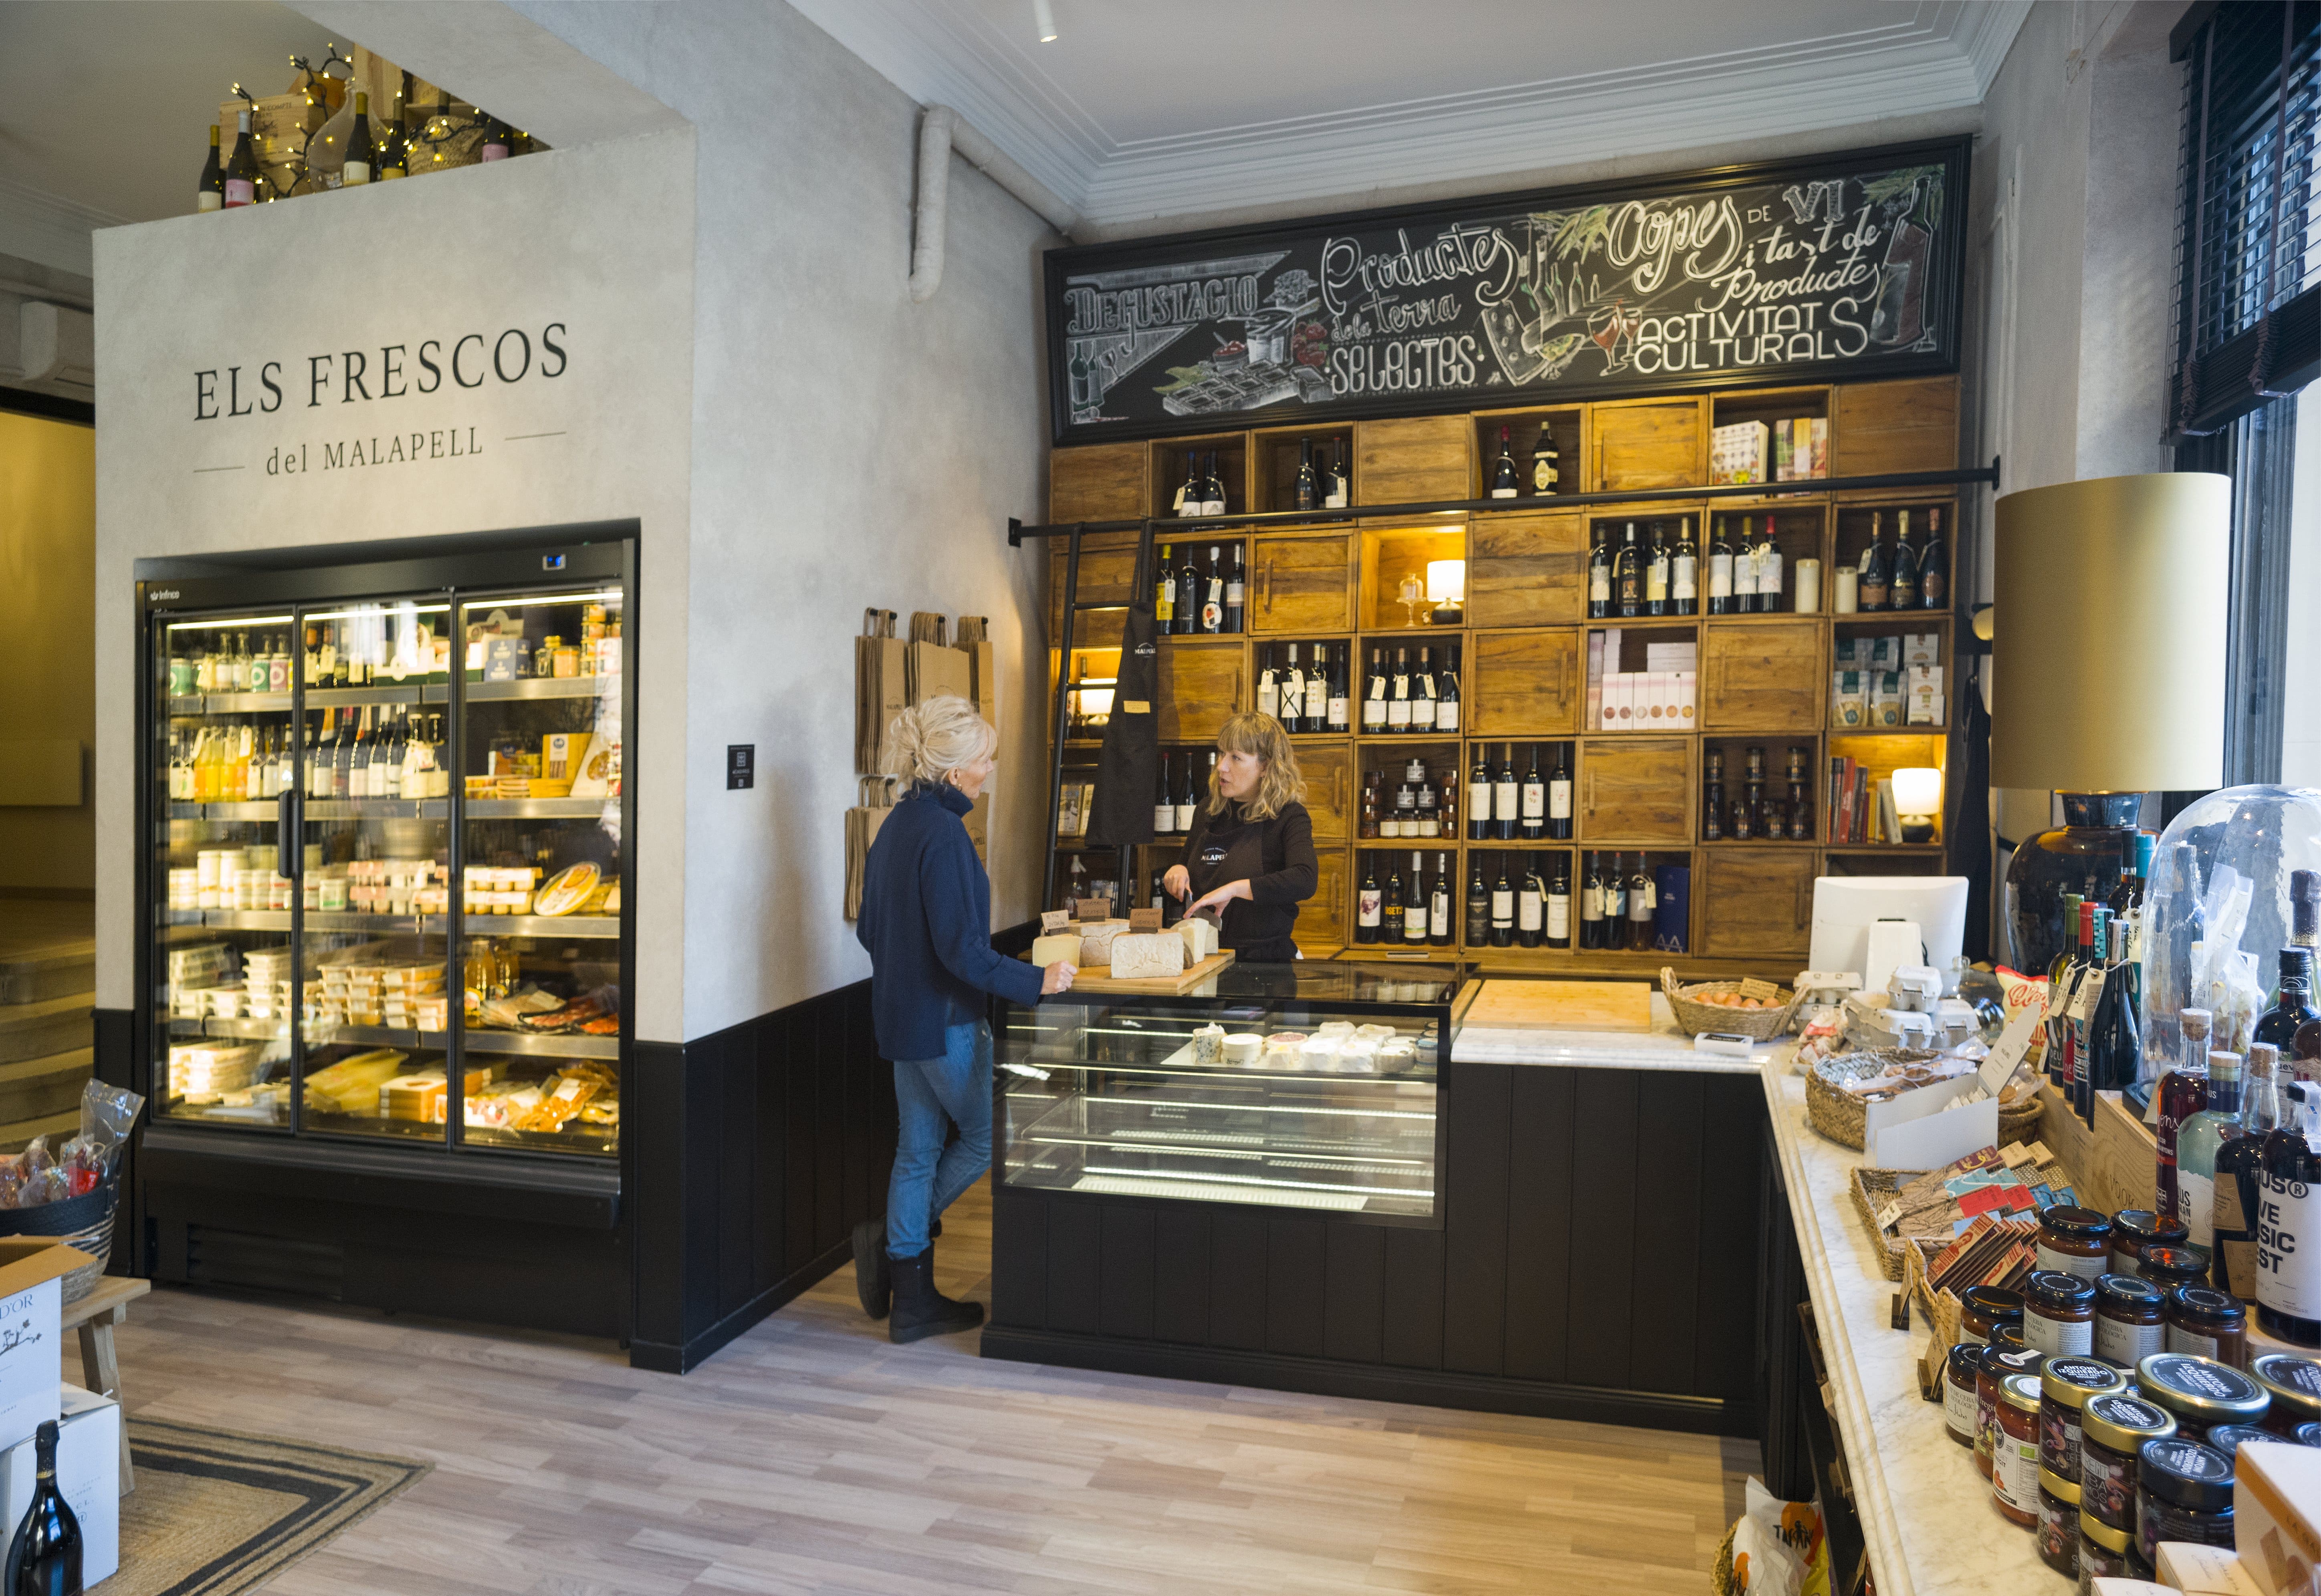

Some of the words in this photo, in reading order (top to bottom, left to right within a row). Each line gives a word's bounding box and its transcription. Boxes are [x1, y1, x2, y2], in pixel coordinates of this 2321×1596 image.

[1606, 195, 1743, 294] Copes
[1748, 205, 1772, 226] DE
[1783, 179, 1844, 224] VI
[1841, 205, 1883, 249] de
[1362, 289, 1462, 334] terra
[194, 362, 283, 421] ELS
[307, 323, 568, 408] FRESCOS
[266, 445, 308, 476] del
[323, 427, 483, 470] MALAPELL
[2180, 1363, 2226, 1397] IZQUIERDO
[2198, 1369, 2234, 1393] ANTONI
[2111, 1400, 2148, 1426] IZQUIERDO
[2124, 1404, 2151, 1422] ANTONI
